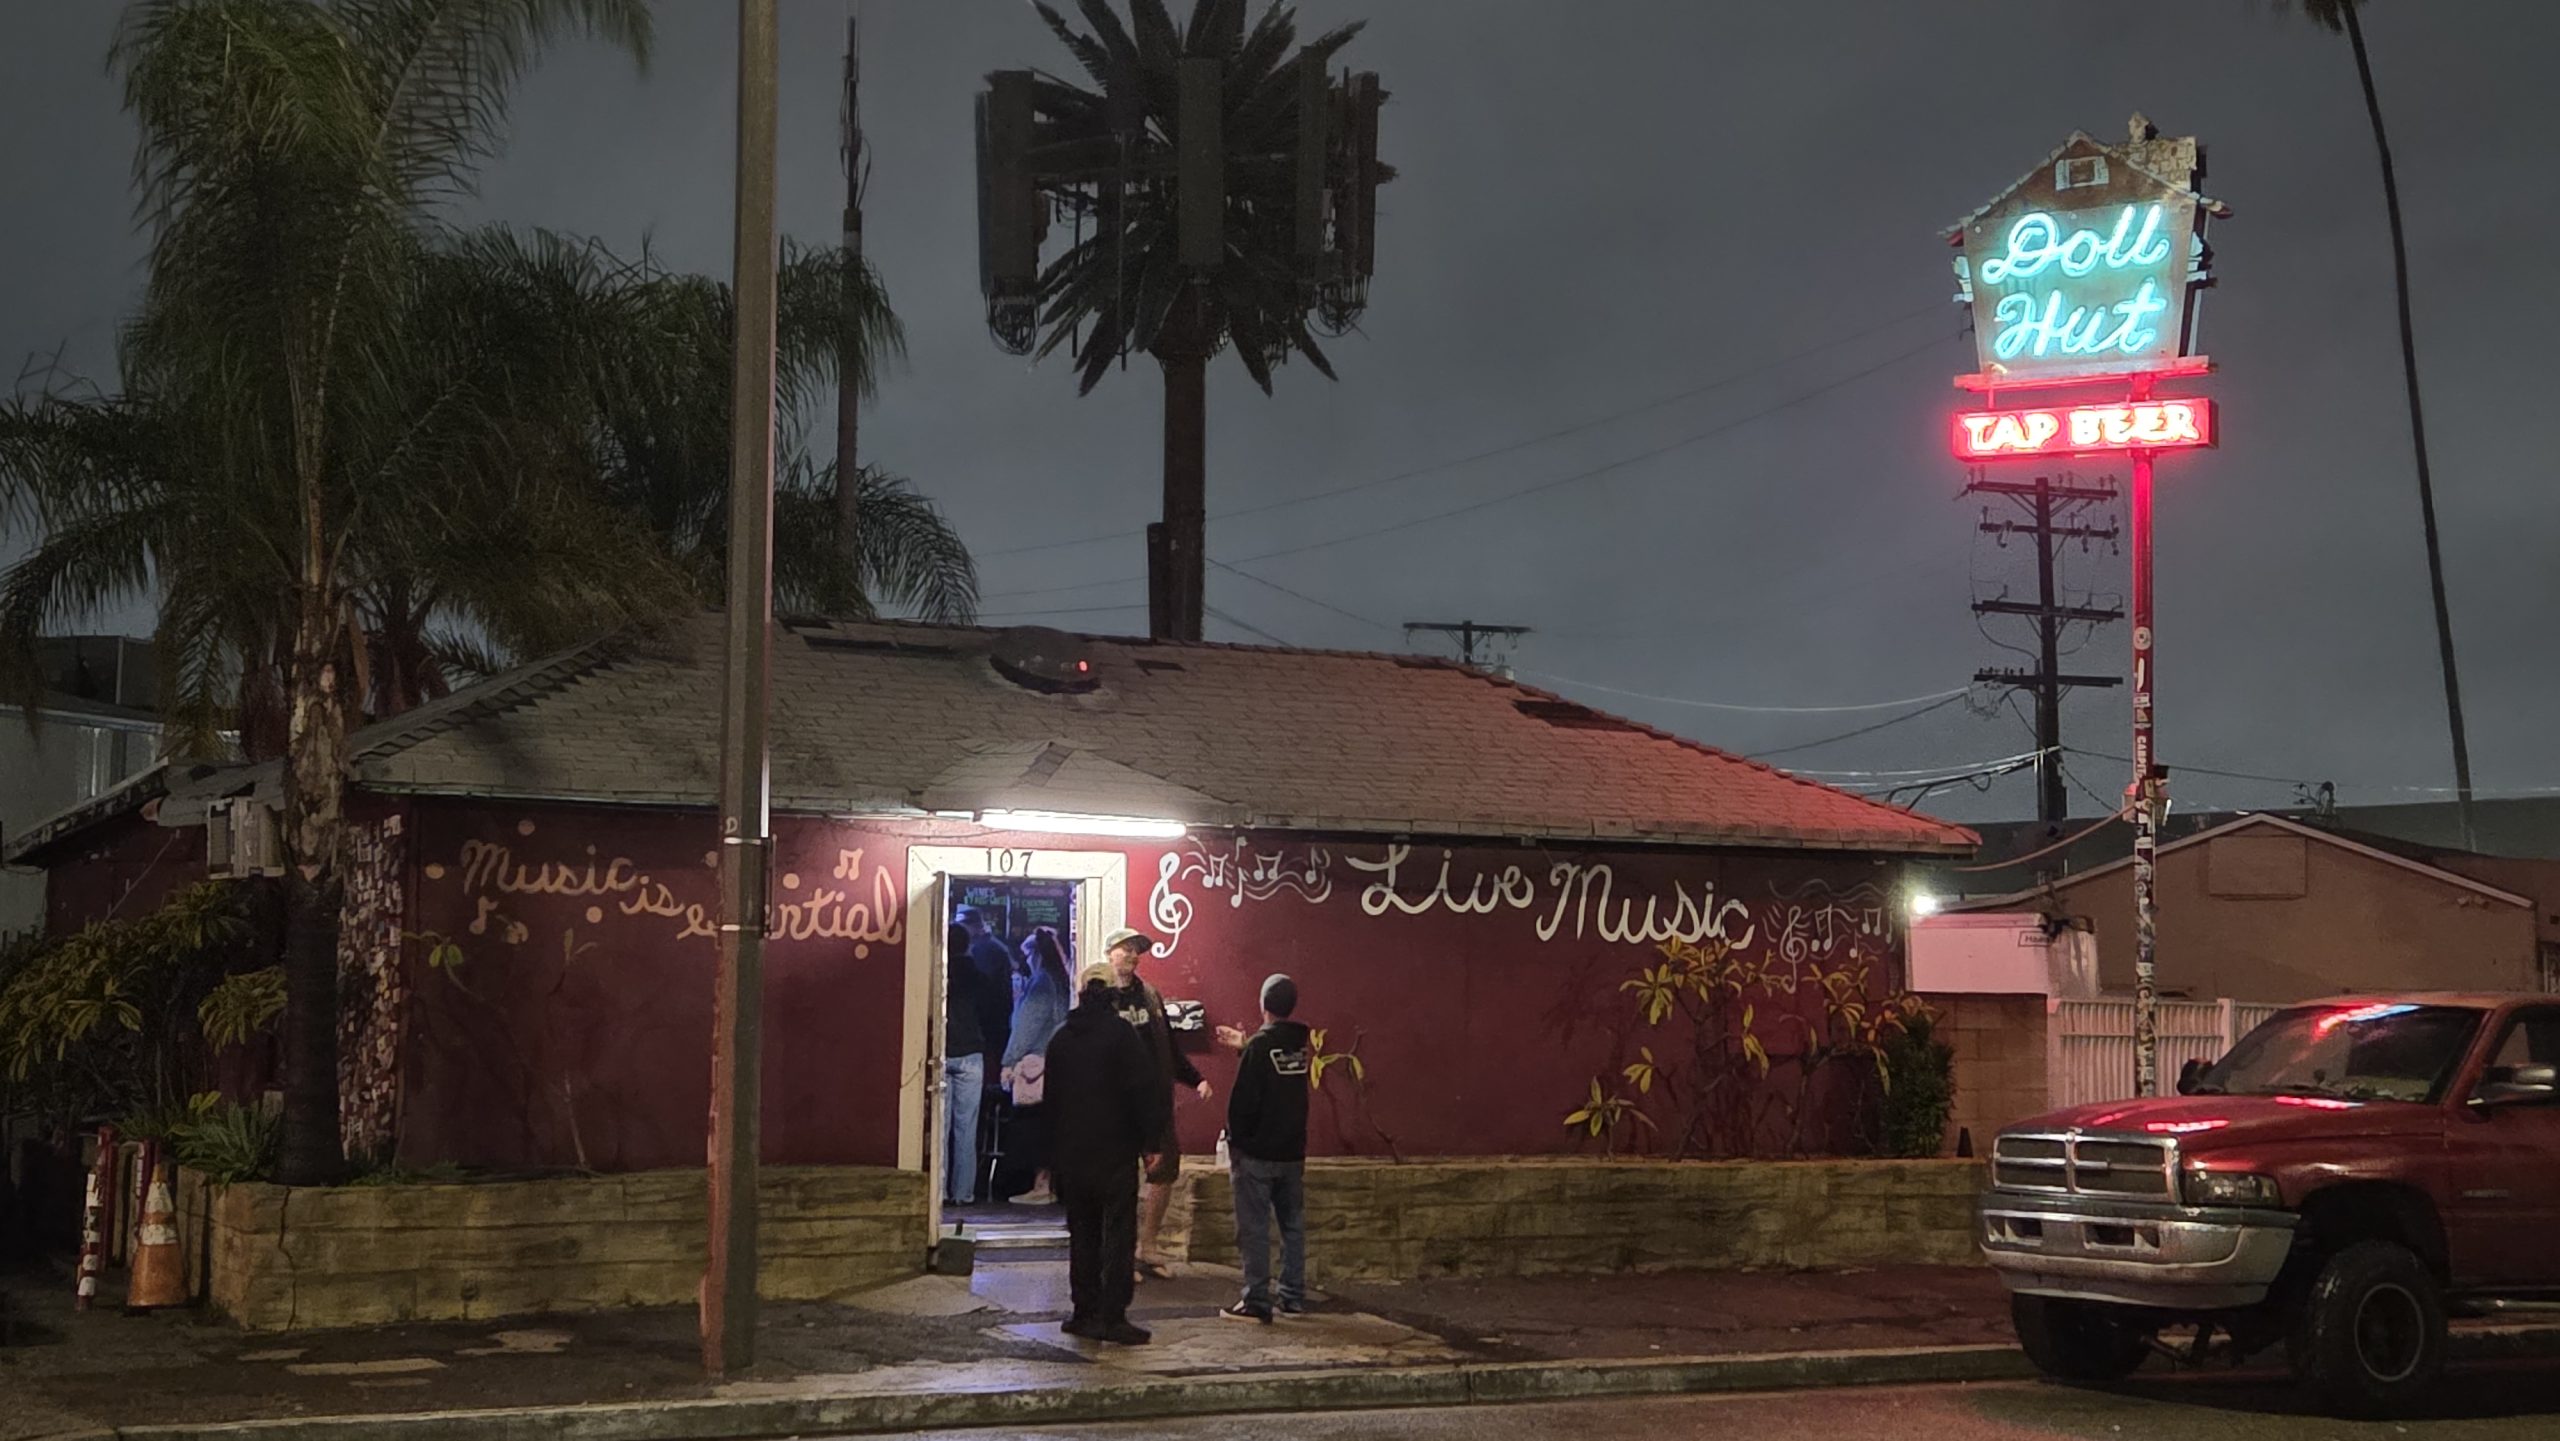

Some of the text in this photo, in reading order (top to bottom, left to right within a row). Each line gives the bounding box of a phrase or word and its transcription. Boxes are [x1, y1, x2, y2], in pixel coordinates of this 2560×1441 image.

[1980, 203, 2170, 286] Doll
[1993, 276, 2168, 360] Hut
[1963, 402, 2201, 451] TAP BEER
[461, 839, 903, 945] Music is ential
[985, 847, 1034, 879] 107
[1344, 843, 1756, 950] Live Music
